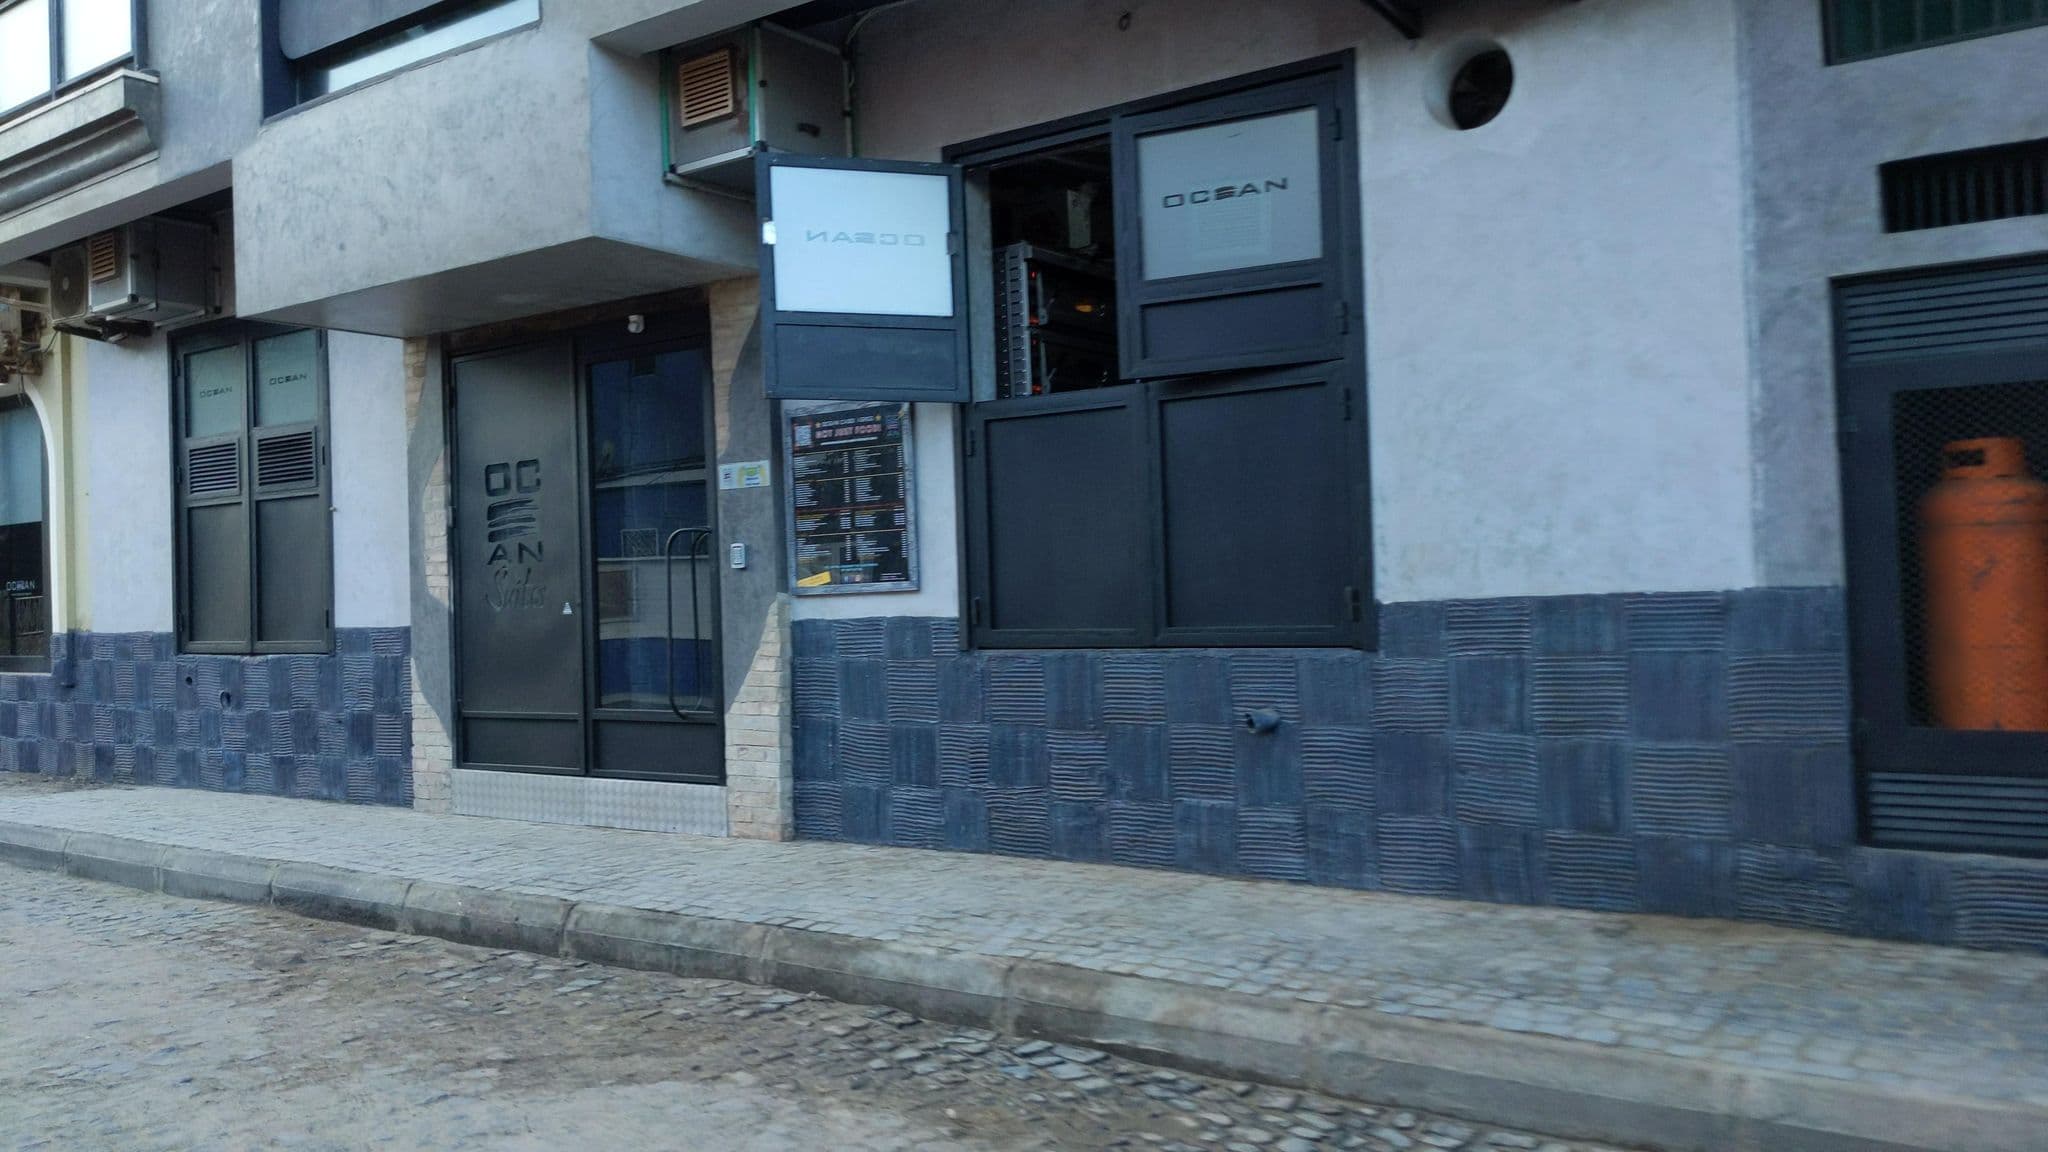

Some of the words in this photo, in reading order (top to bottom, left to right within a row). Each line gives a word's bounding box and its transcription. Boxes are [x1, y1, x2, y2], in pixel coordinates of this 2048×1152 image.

[1163, 178, 1288, 208] OCEAN
[269, 373, 308, 386] OCEAN
[199, 386, 233, 399] OCEAN
